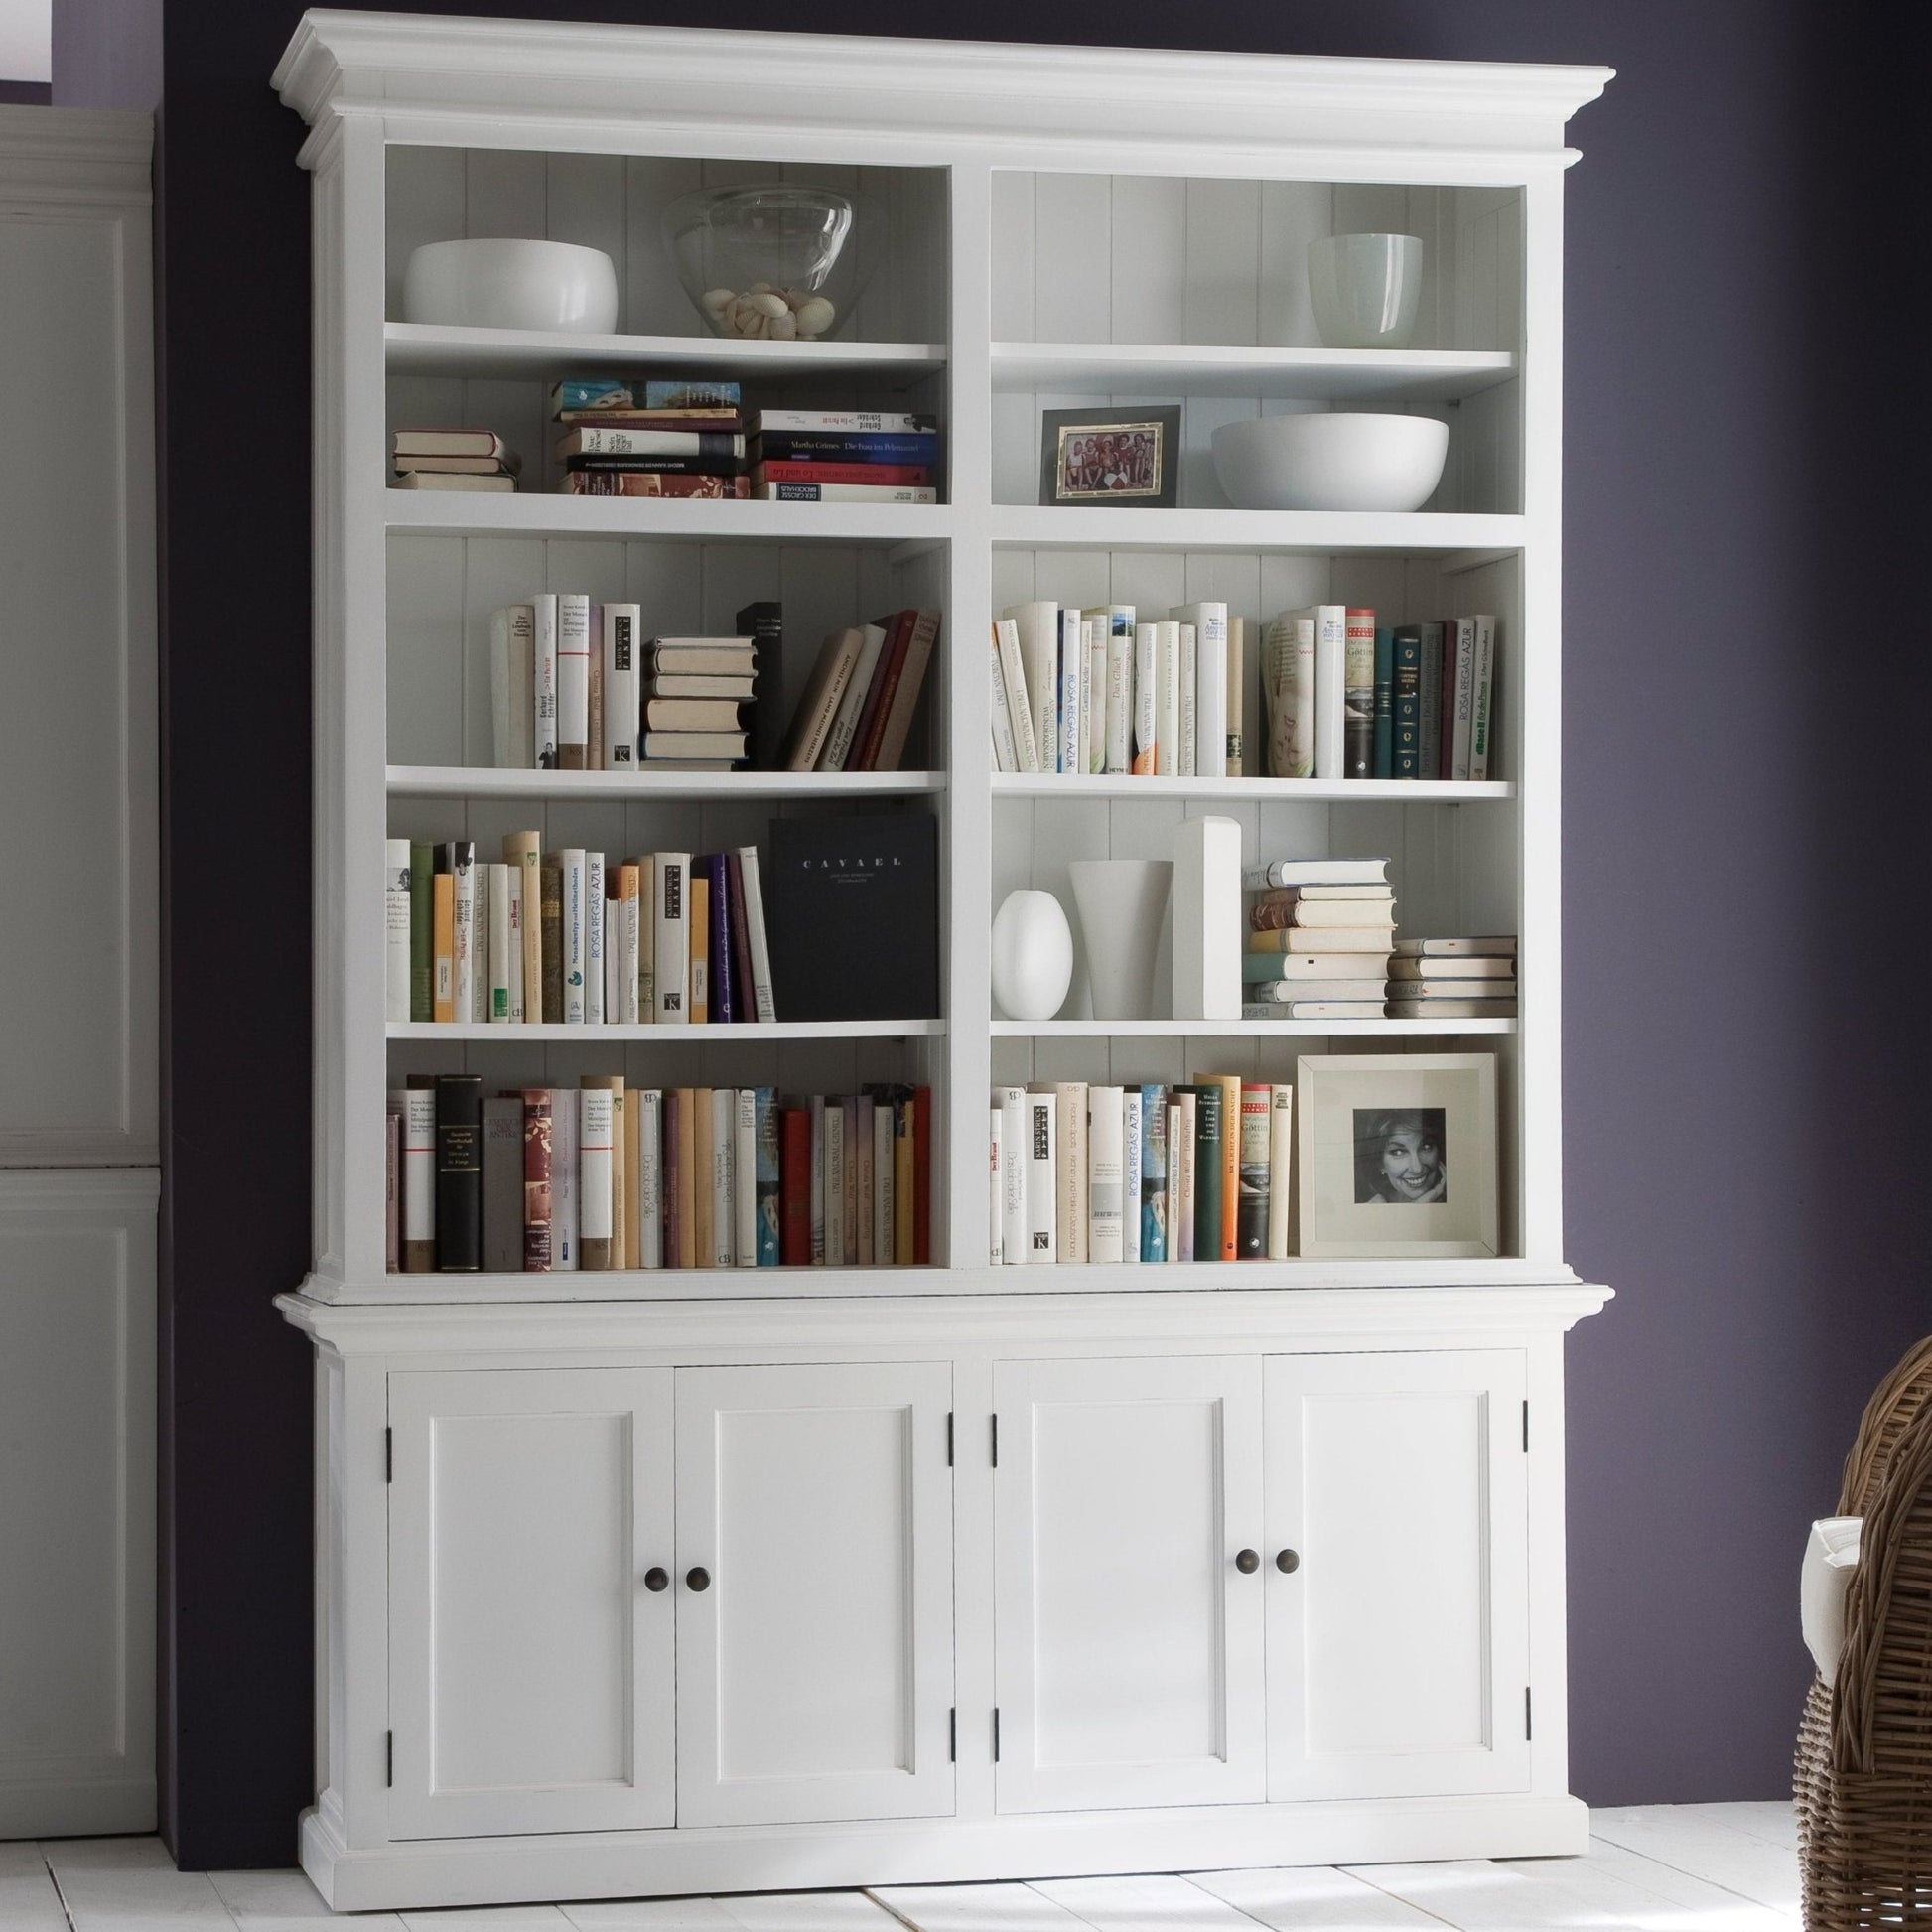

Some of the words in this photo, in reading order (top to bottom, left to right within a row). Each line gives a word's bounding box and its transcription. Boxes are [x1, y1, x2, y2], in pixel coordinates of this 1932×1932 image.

[859, 421, 882, 430] Gerhard
[815, 441, 840, 450] Grimes
[786, 469, 802, 479] und
[1462, 627, 1471, 655] AZUR
[1112, 657, 1121, 681] Glück
[1458, 657, 1471, 691] REGÁS
[1066, 675, 1076, 702] ROSA
[1112, 683, 1121, 699] Das
[824, 696, 834, 713] LAND
[1459, 693, 1469, 720] ROSA
[814, 715, 829, 737] MEINES
[1066, 705, 1078, 739] REGÁS
[804, 738, 819, 763] HERZENS
[1475, 729, 1485, 755] dBase
[619, 752, 627, 761] K
[828, 750, 838, 764] Zeit
[1066, 741, 1076, 768] AZUR
[802, 857, 901, 869] CAVAEL
[589, 892, 600, 927] REGÁS
[669, 999, 678, 1010] K
[1126, 1132, 1138, 1166] REGÁS
[643, 1154, 652, 1170] Das
[1007, 1151, 1017, 1165] Das
[1129, 1170, 1138, 1197] ROSA
[643, 1187, 652, 1201] der
[723, 1187, 732, 1203] Das
[1036, 1237, 1046, 1248] K
